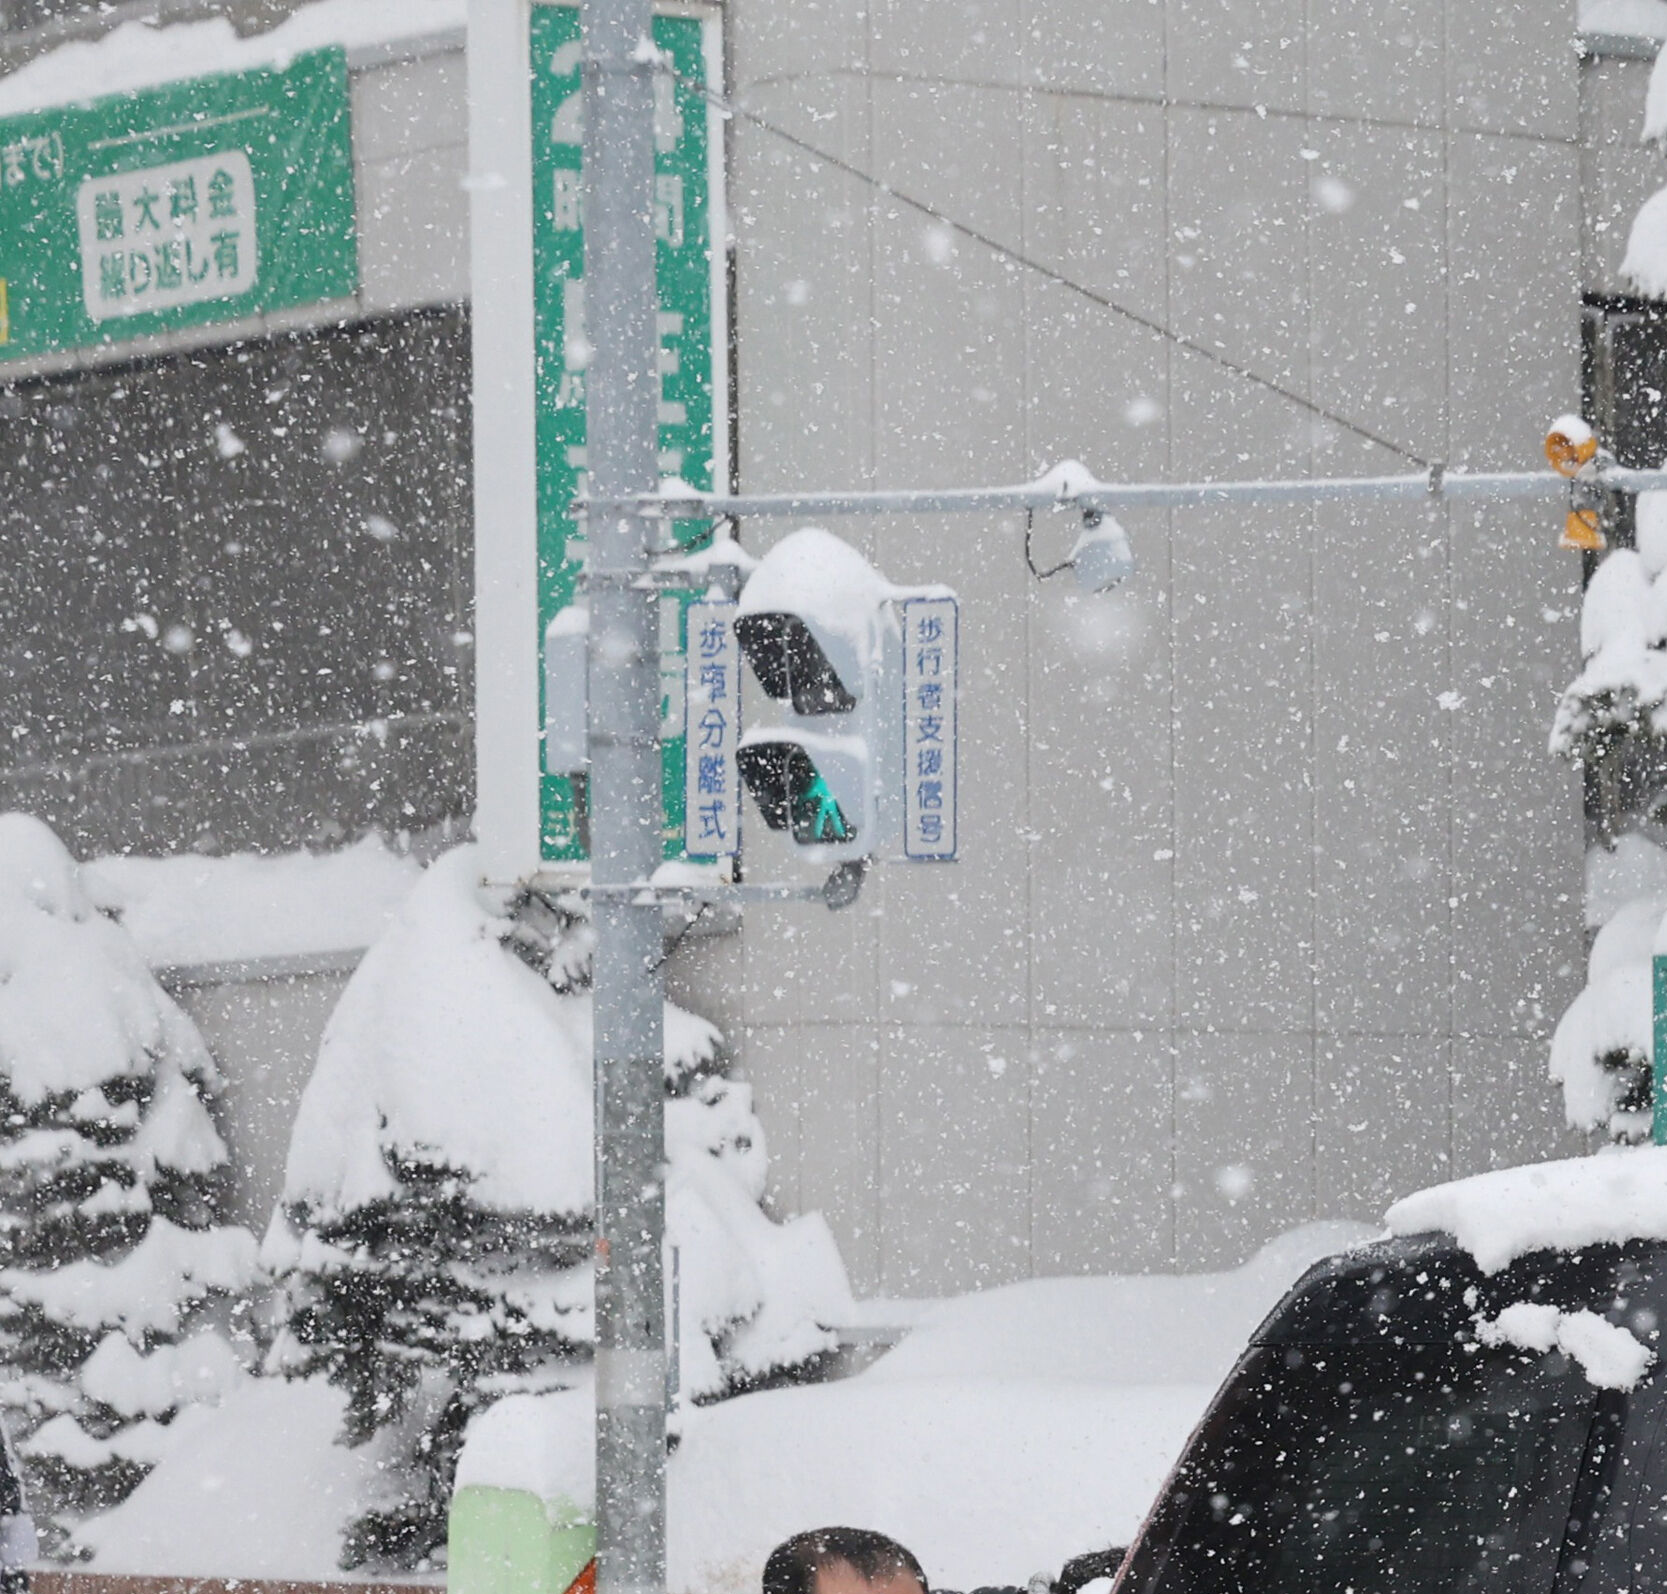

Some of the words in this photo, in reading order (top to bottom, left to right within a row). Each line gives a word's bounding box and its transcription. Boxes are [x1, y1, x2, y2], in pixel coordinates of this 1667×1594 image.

[698, 617, 727, 841] 歩車分離式
[916, 615, 945, 844] 歩行者支援信号
